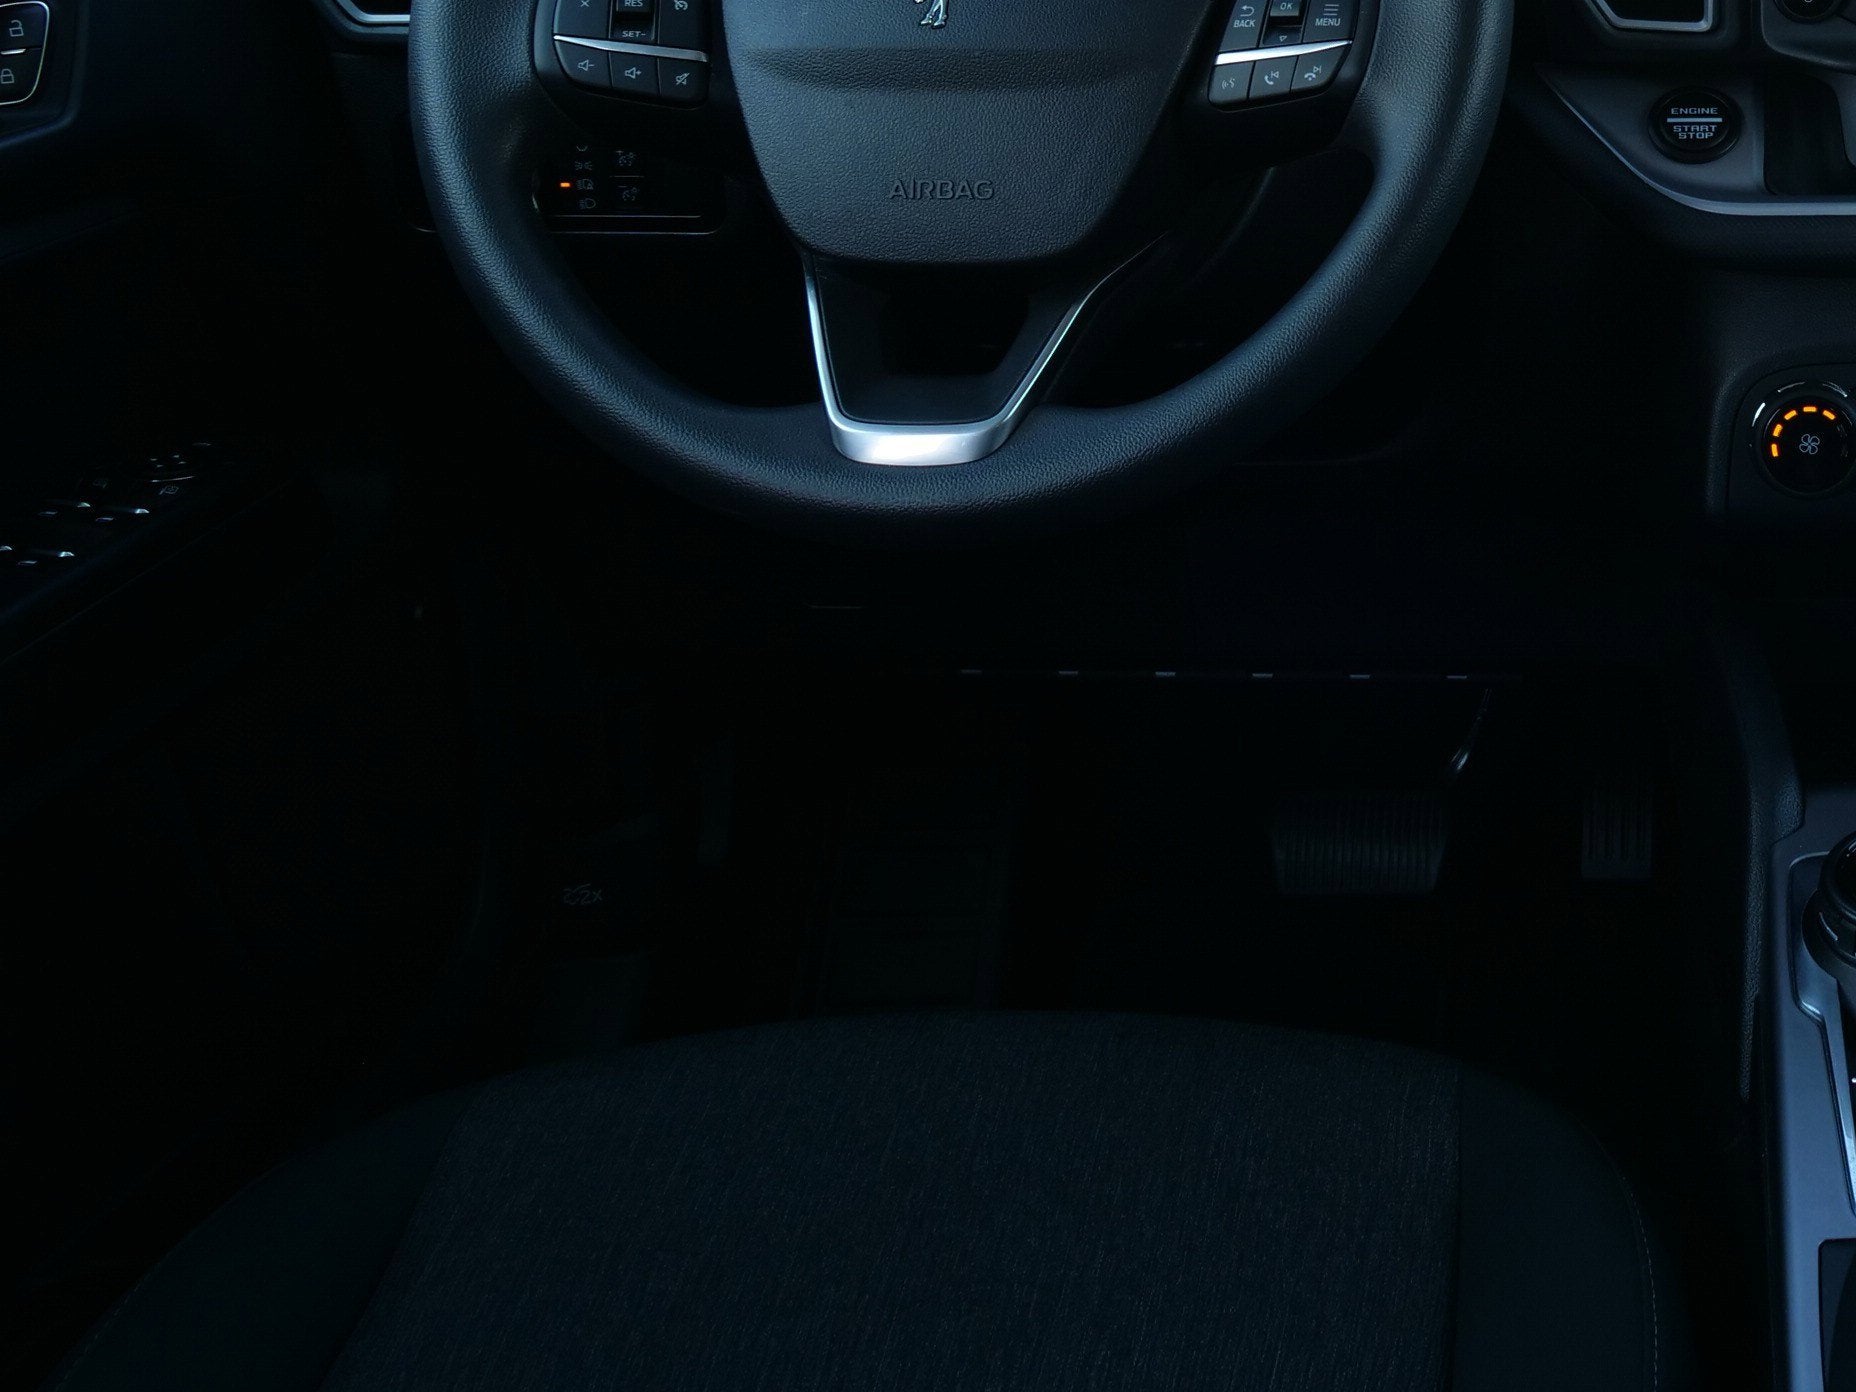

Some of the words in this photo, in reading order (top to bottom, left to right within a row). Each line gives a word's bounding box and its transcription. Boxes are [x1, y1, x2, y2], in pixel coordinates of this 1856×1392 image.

[1279, 2, 1293, 10] OK
[1233, 19, 1256, 28] BACK
[1315, 18, 1341, 26] MENU
[1670, 107, 1718, 115] ENGINE
[1673, 124, 1718, 132] START
[1678, 131, 1715, 139] STOP
[889, 179, 995, 200] AIRBAG
